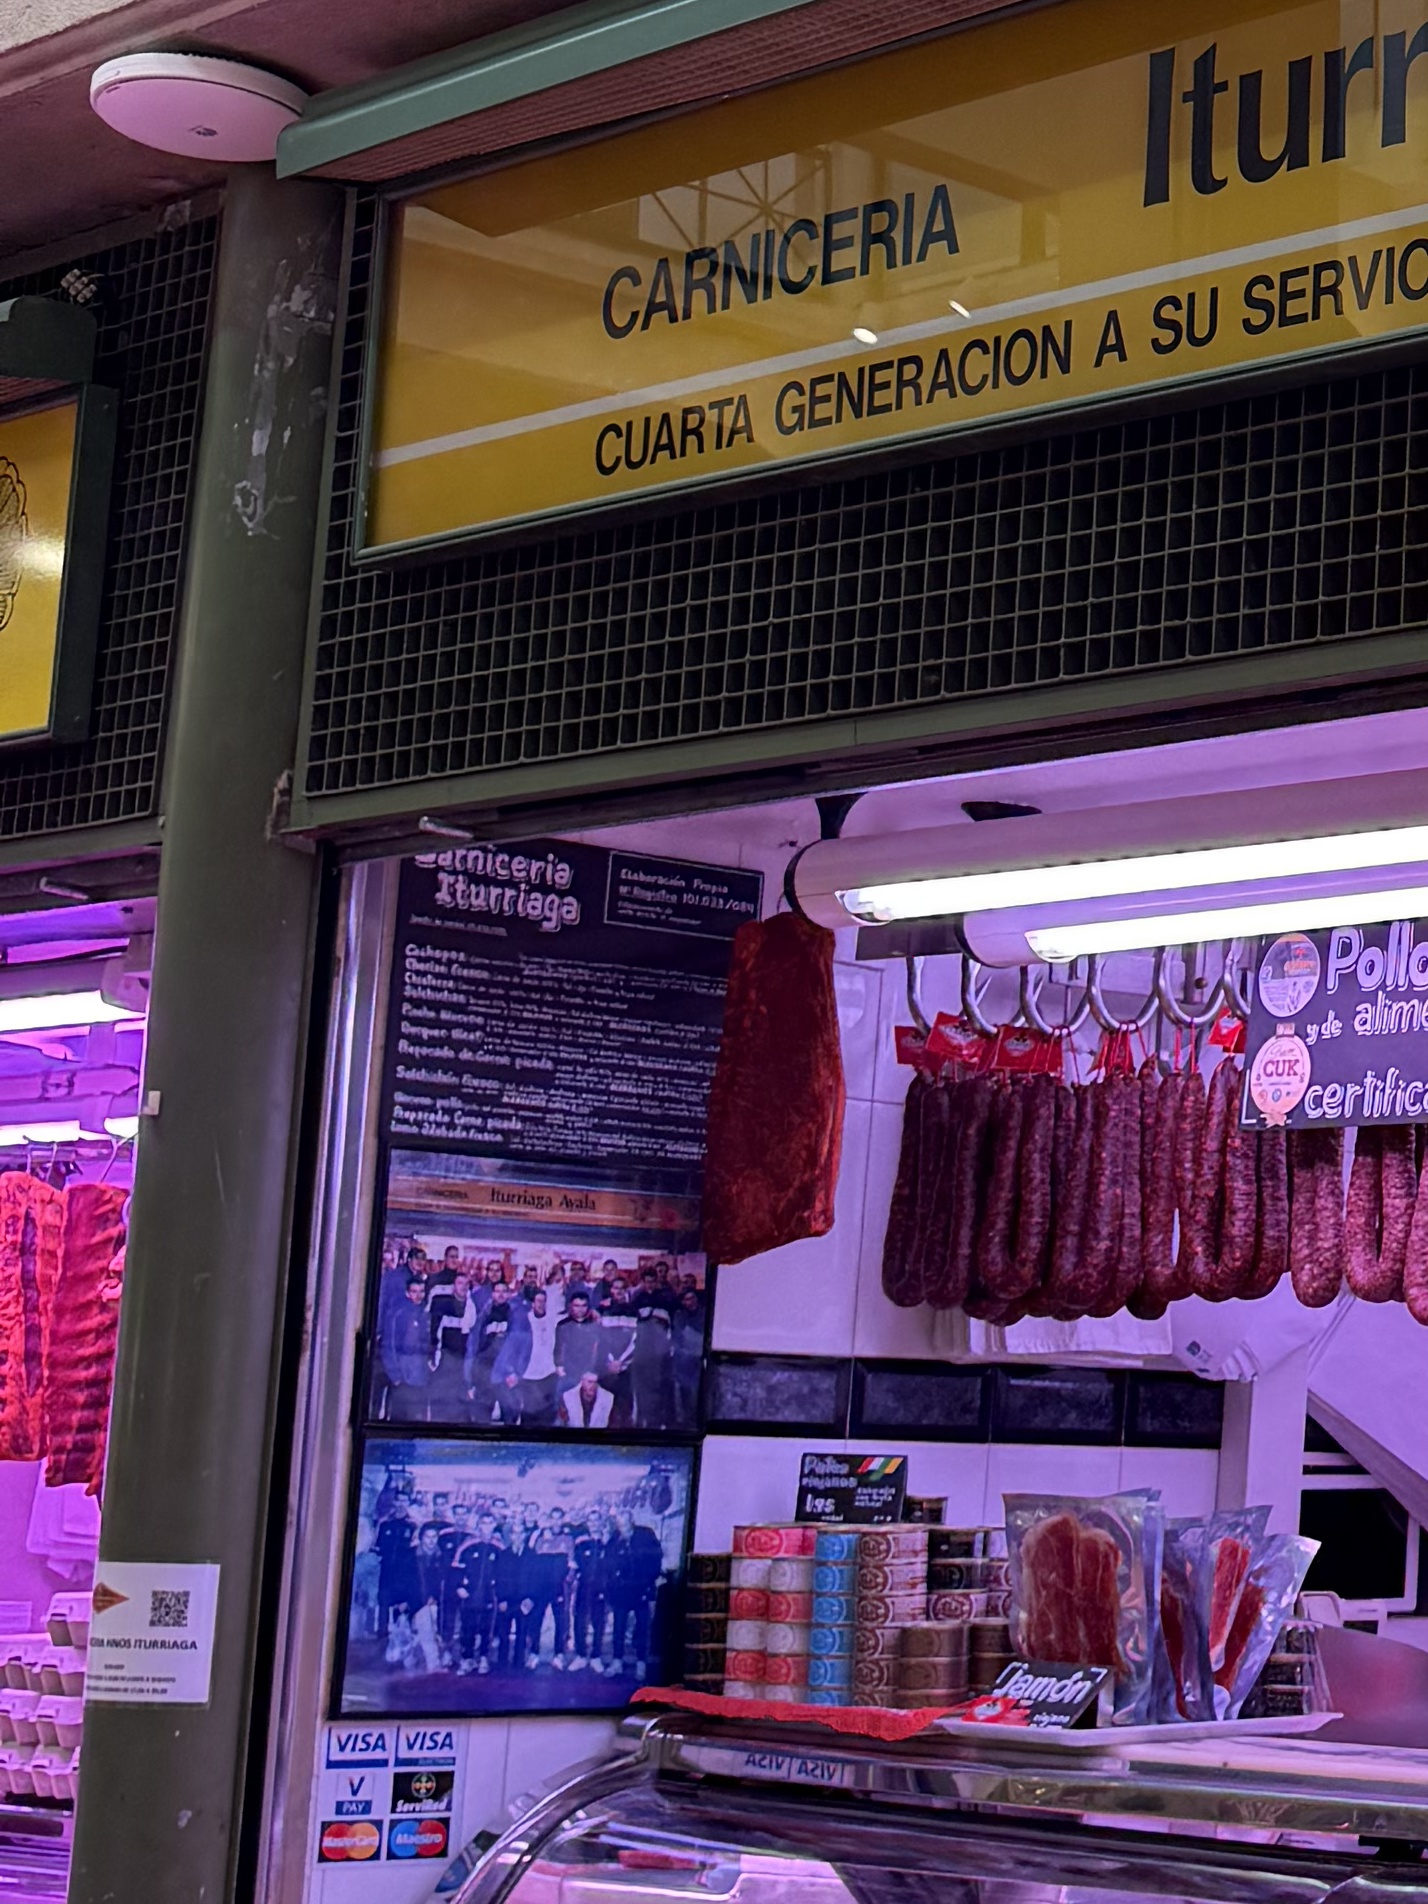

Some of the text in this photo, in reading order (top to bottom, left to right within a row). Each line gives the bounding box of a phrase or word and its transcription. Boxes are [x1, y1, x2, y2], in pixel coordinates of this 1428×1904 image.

[602, 184, 959, 339] CARNICERIA
[596, 394, 755, 476] CUARTA
[775, 318, 1073, 438] GENERACION
[1094, 308, 1130, 370] A
[1150, 283, 1220, 354] SU
[436, 871, 581, 932] Iturriaga
[1263, 1059, 1298, 1077] CUK
[559, 1193, 596, 1209] Ayala
[134, 1639, 198, 1650] ITURRIAGA
[992, 1666, 1093, 1704] Jamón
[337, 1732, 453, 1752] VISA VISA
[343, 1777, 365, 1813] V PAY
